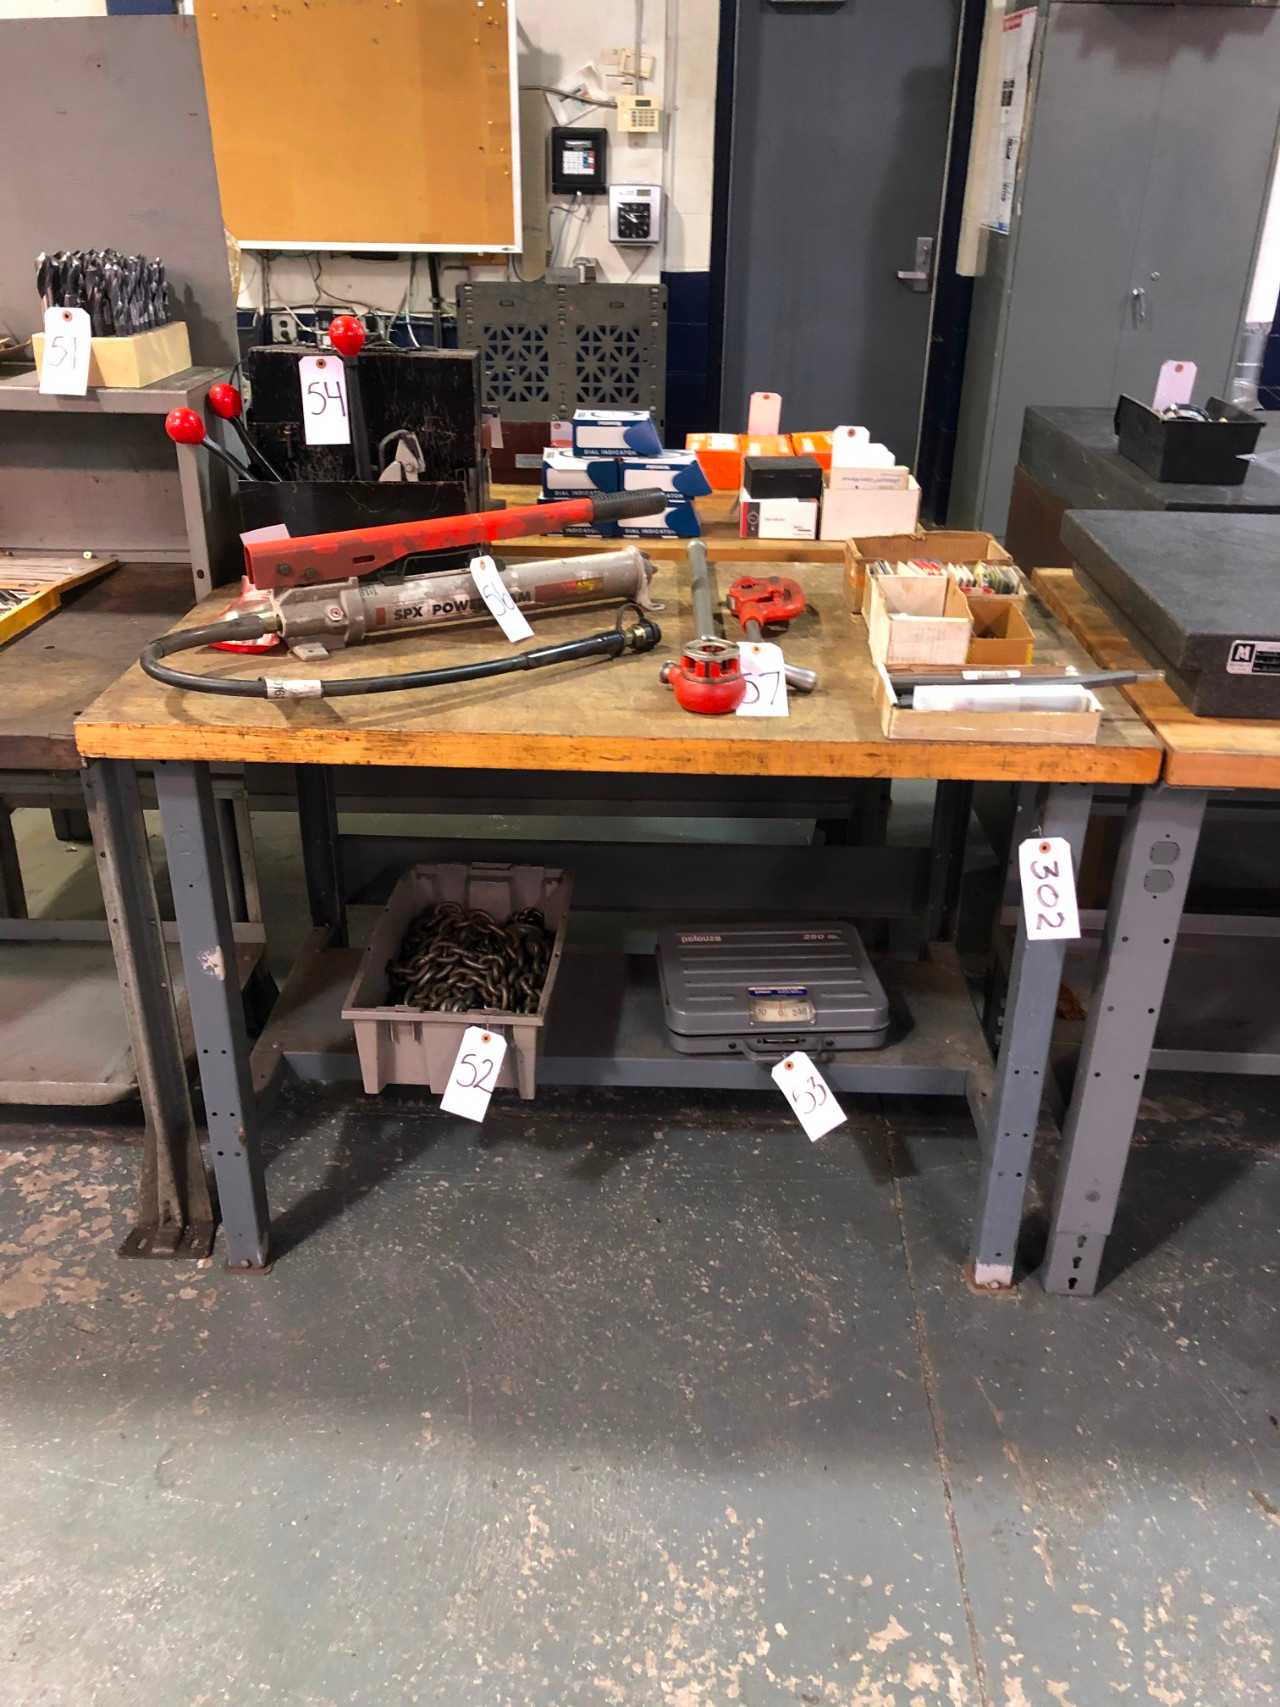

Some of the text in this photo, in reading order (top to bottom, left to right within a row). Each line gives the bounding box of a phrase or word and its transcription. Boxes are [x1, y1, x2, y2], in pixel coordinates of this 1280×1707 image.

[48, 335, 77, 369] 51
[307, 380, 346, 417] 54
[394, 605, 424, 620] SPX
[740, 671, 780, 705] 57
[1029, 860, 1066, 931] 302
[456, 1053, 493, 1095] 52
[792, 1075, 828, 1115] 53
